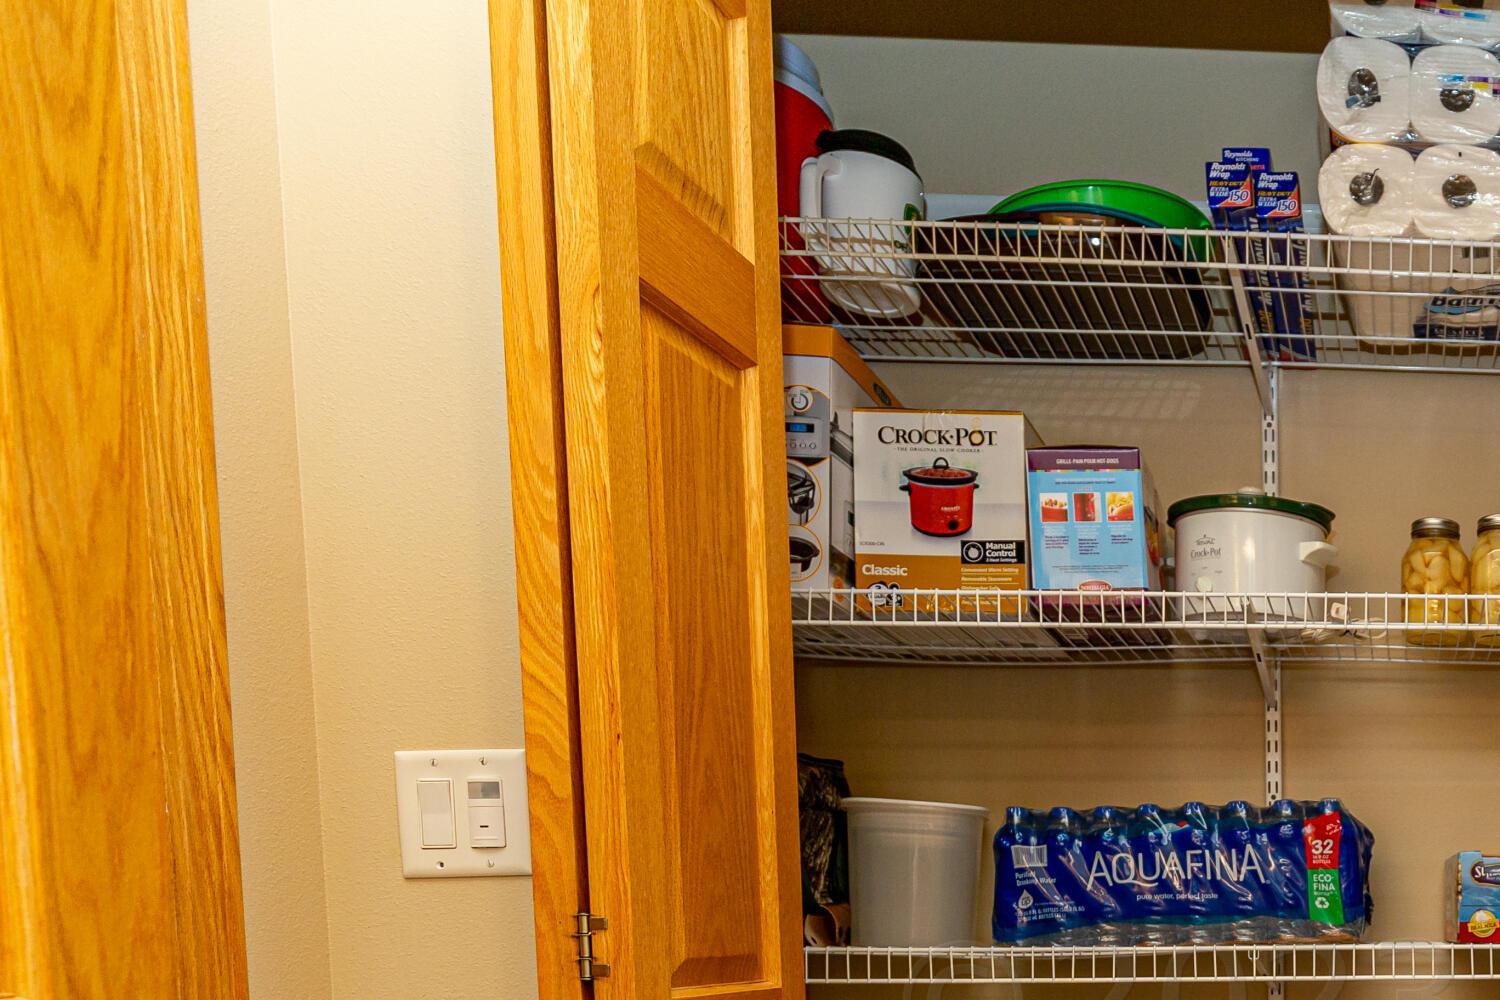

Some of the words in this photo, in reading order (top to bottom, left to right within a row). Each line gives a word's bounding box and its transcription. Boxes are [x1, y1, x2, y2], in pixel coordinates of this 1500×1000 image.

[1223, 149, 1253, 158] Reynolds
[1211, 162, 1246, 172] Reynolds
[1209, 170, 1231, 179] Wrap
[1259, 172, 1294, 182] Reynolds
[1257, 181, 1279, 190] Wrap
[1229, 190, 1250, 202] 150
[1276, 199, 1298, 212] 150
[985, 549, 1016, 557] Control
[862, 564, 908, 576] Classic
[1311, 839, 1334, 855] 32
[1087, 843, 1266, 891] AQUAFINA
[1312, 874, 1334, 883] ECO-
[1312, 882, 1335, 891] FINA
[1176, 893, 1201, 901] perfect
[1202, 893, 1219, 902] taste
